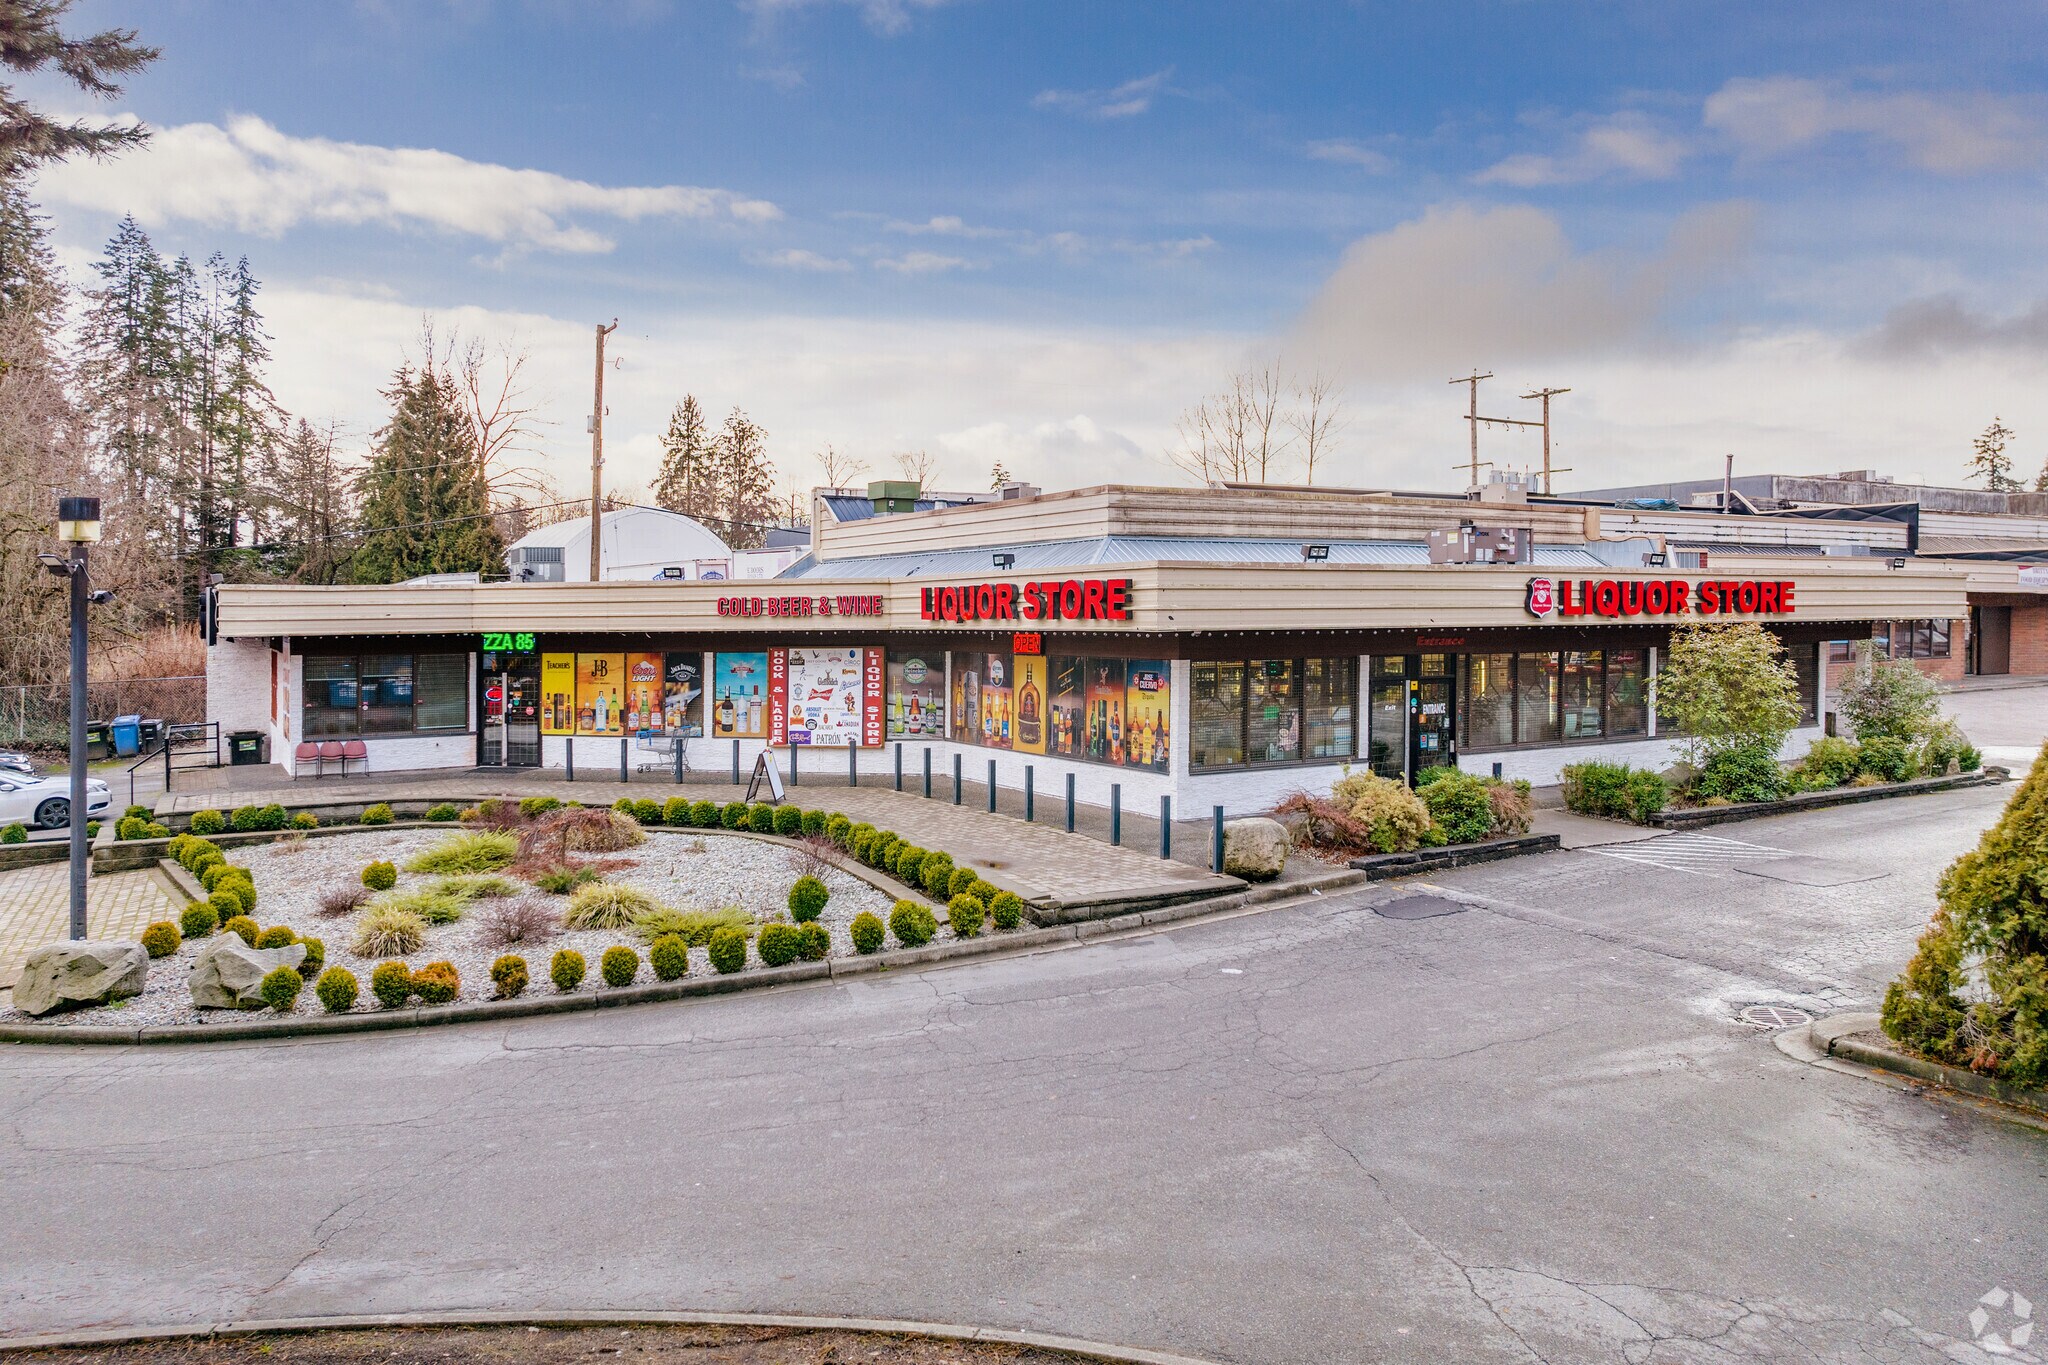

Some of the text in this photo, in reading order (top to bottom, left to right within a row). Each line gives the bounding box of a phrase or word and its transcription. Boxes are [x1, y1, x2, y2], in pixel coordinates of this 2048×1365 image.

[717, 595, 884, 617] COLD BEER & WINE
[921, 578, 1128, 623] LIQUOR STORE
[1560, 580, 1796, 618] LIQUOR STORE
[483, 633, 534, 650] ZZA 85
[1014, 636, 1041, 651] OPEN
[1416, 635, 1466, 646] Entrance
[546, 660, 571, 670] TEACHER'S
[631, 663, 658, 676] Coors
[773, 651, 784, 678] HOOK
[1139, 680, 1158, 690] CUERVO
[866, 651, 882, 744] LIQUOR STORE
[1422, 703, 1447, 715] ENTRANCE
[773, 701, 784, 743] LADDER
[816, 732, 841, 744] PATRÓN
